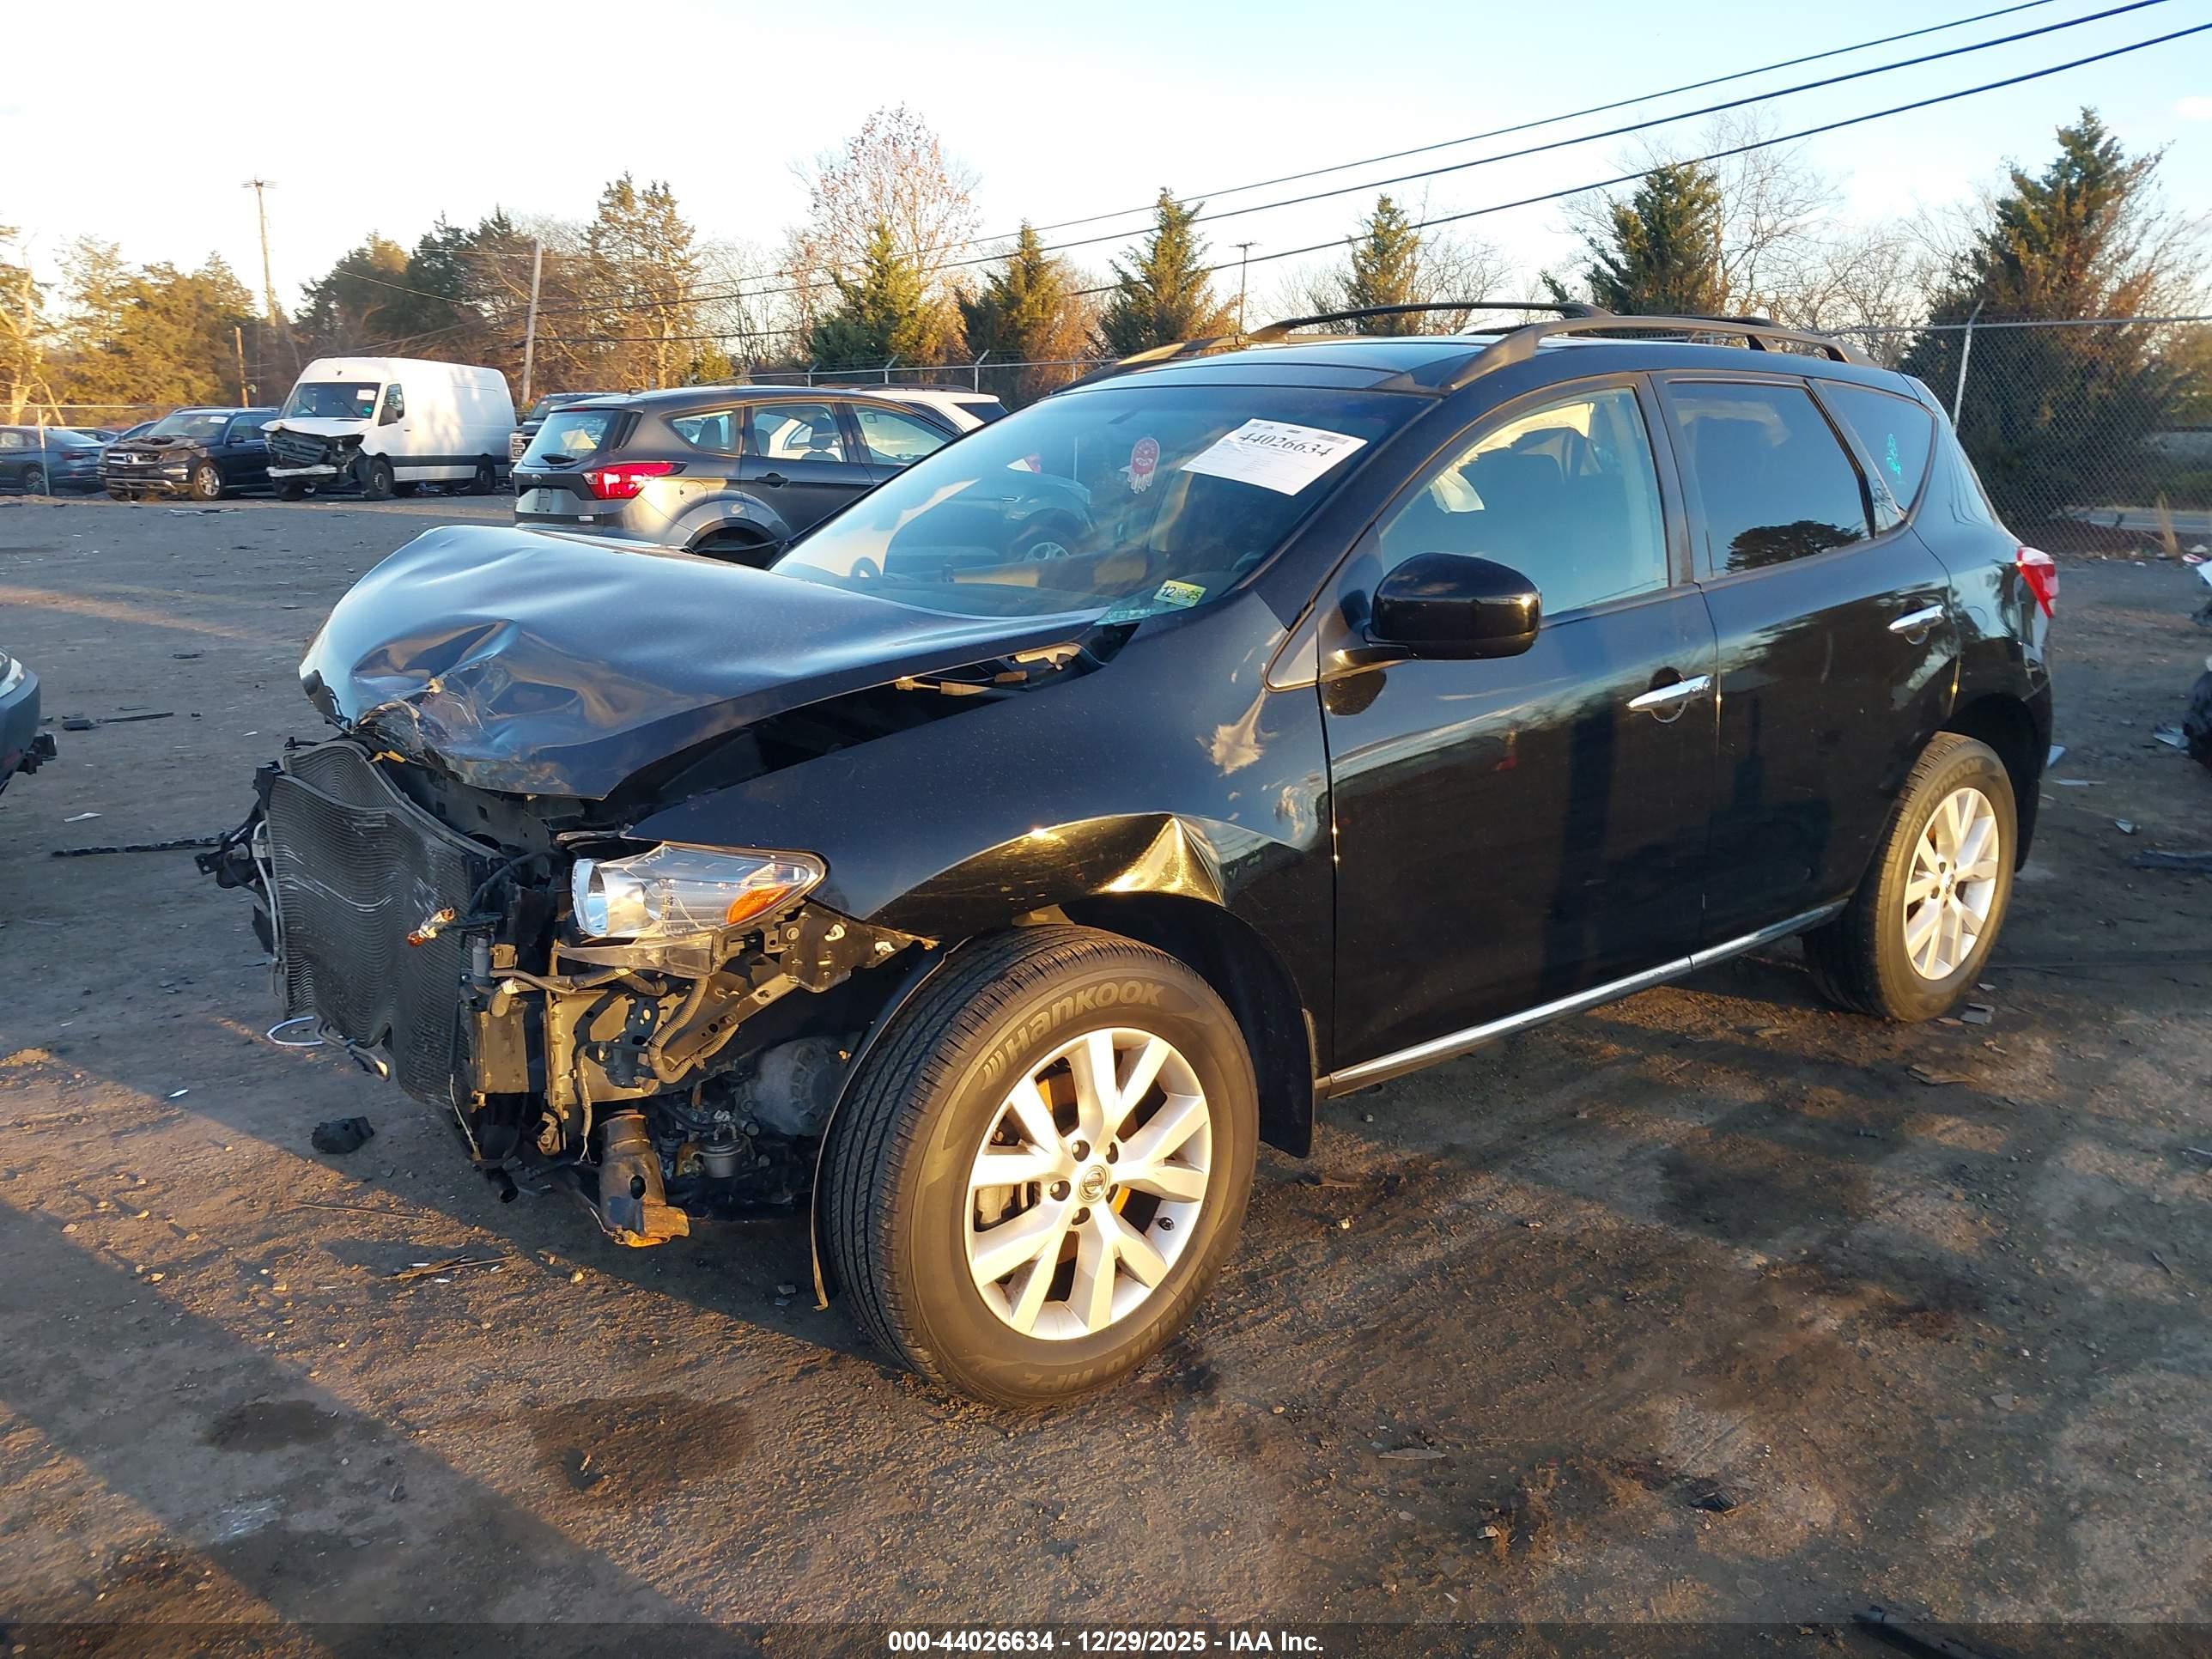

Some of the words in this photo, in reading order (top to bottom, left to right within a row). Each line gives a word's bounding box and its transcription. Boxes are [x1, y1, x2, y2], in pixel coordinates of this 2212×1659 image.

[1238, 432, 1335, 457] 44026634
[1161, 585, 1177, 599] 12
[1186, 590, 1202, 601] 25
